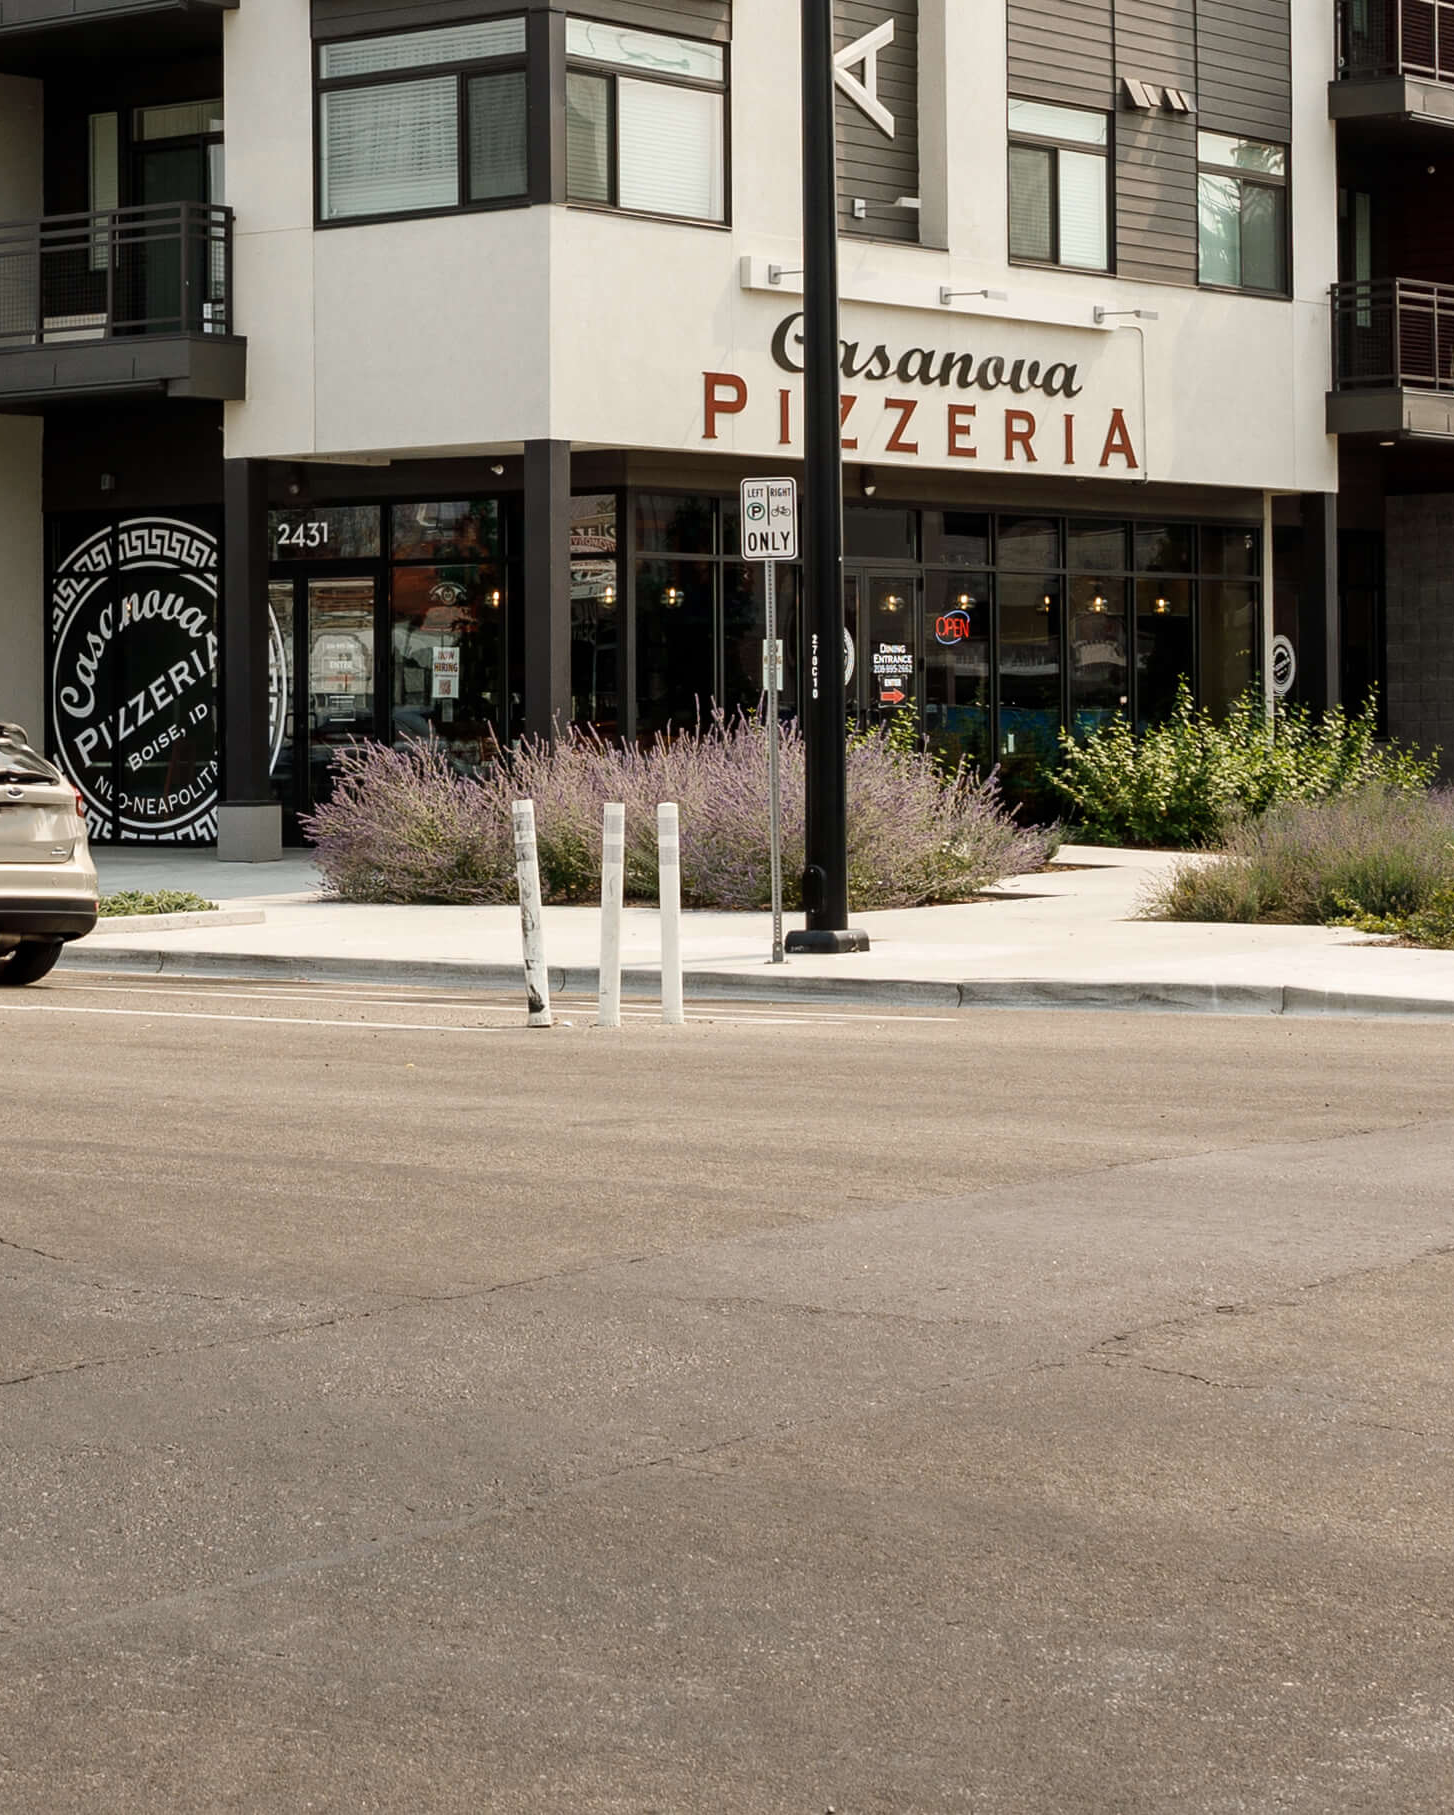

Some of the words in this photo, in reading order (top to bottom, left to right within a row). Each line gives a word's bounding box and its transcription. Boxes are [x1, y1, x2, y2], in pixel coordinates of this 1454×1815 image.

[701, 371, 1139, 469] PIZZERIA
[747, 488, 764, 498] LEFT
[770, 487, 791, 497] RIGHT
[277, 522, 328, 547] 2431
[748, 530, 790, 551] ONLY
[935, 616, 969, 638] OPEN
[433, 663, 458, 672] HIRING
[873, 654, 912, 664] ENTRANCE
[128, 724, 186, 772] BOISE,
[189, 703, 208, 725] ID
